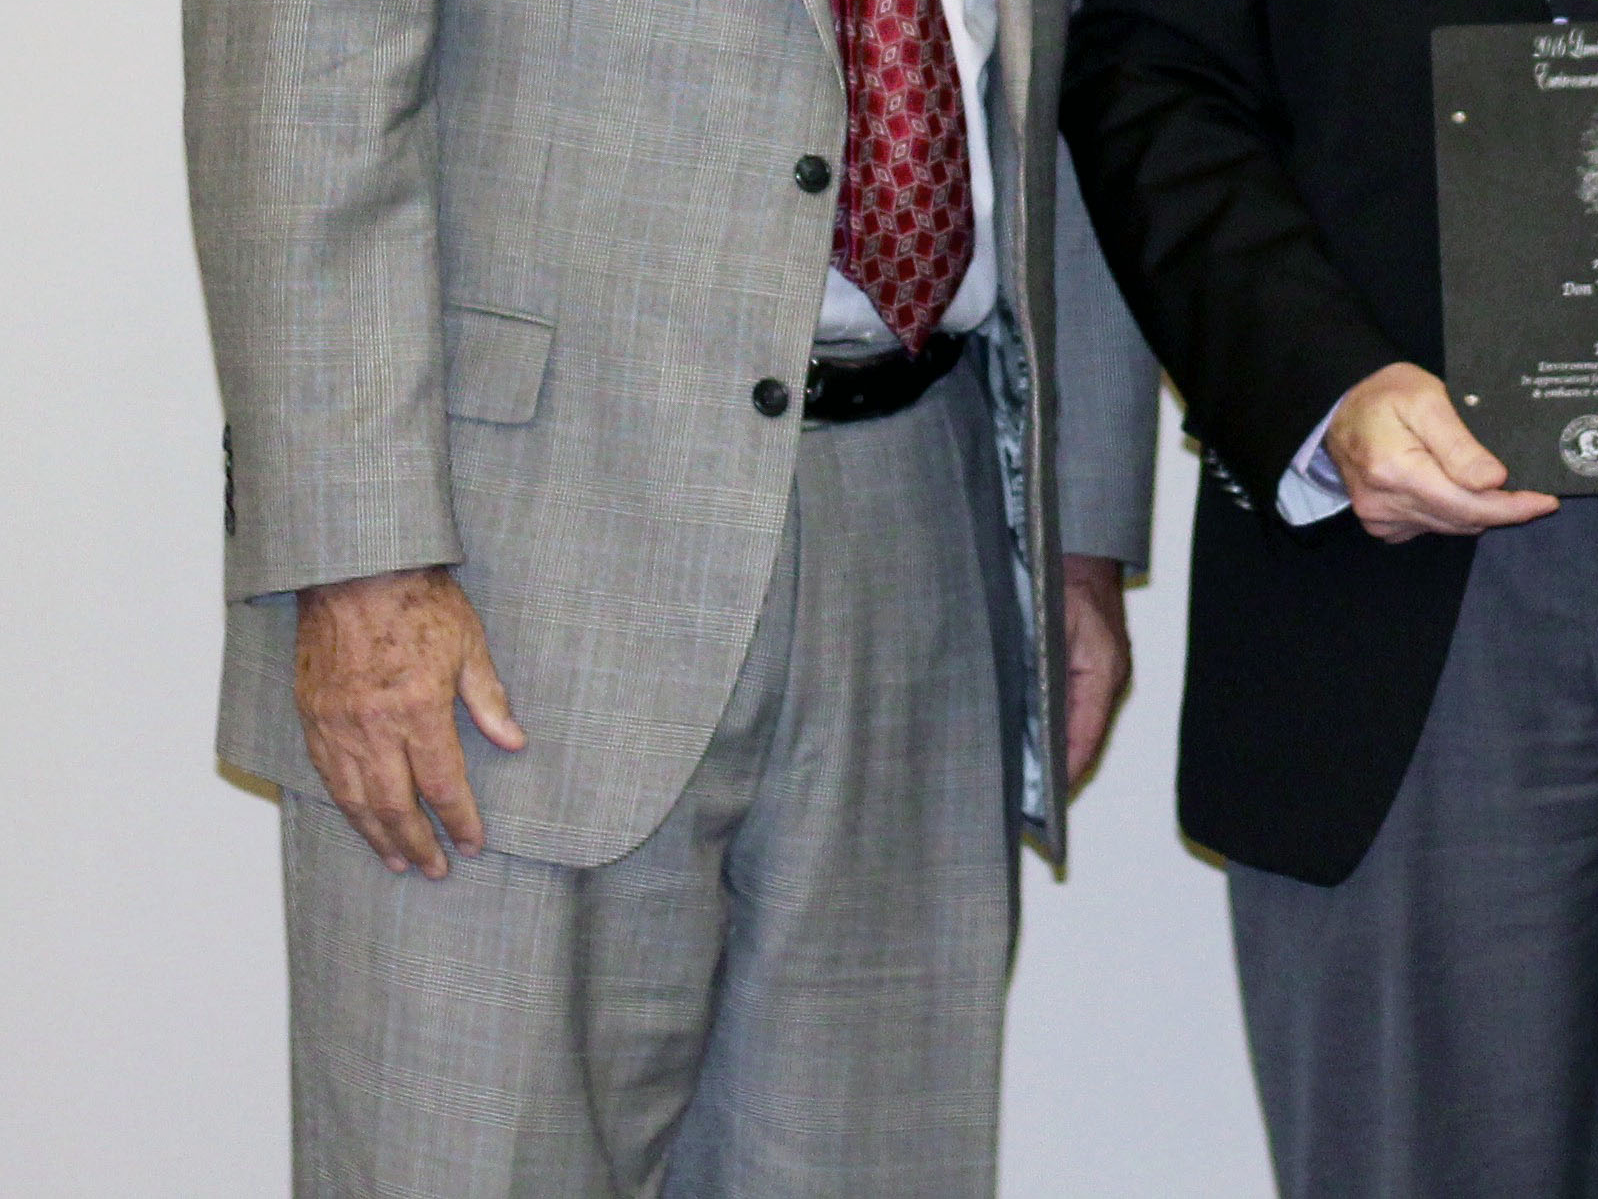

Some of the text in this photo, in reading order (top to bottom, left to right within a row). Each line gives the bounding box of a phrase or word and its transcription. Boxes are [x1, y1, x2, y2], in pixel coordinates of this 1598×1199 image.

[1562, 281, 1592, 296] Don
[1532, 388, 1542, 398] &
[1543, 387, 1590, 398] enhance
